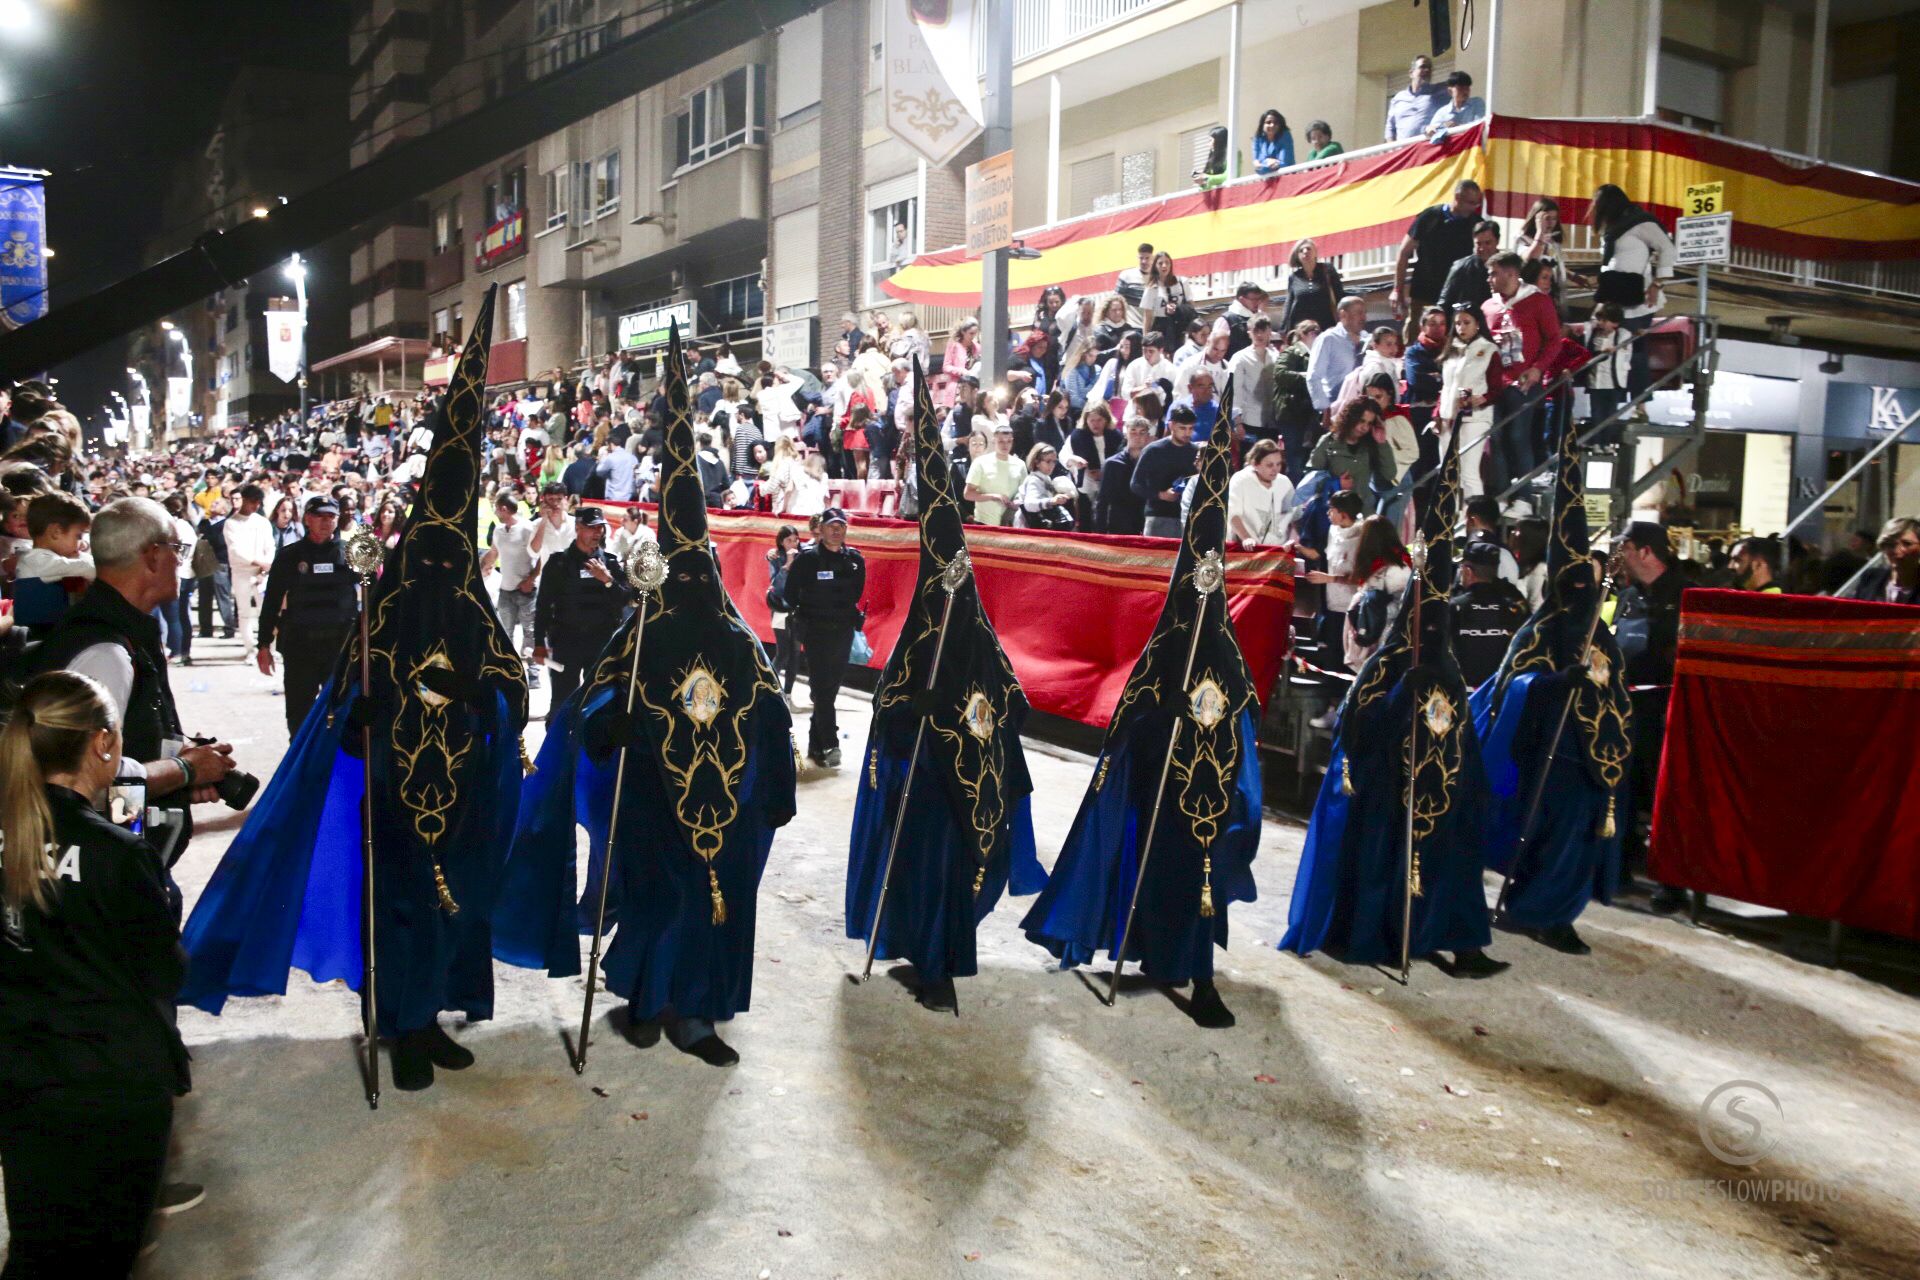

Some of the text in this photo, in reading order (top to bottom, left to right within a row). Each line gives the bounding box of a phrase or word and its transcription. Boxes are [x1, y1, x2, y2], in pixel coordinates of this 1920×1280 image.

[968, 176, 1012, 202] PROHIBIDO
[1687, 184, 1721, 197] Pasillo
[971, 201, 1008, 224] ARROJAR
[1692, 197, 1715, 214] 36
[971, 225, 1007, 249] OBJETOS
